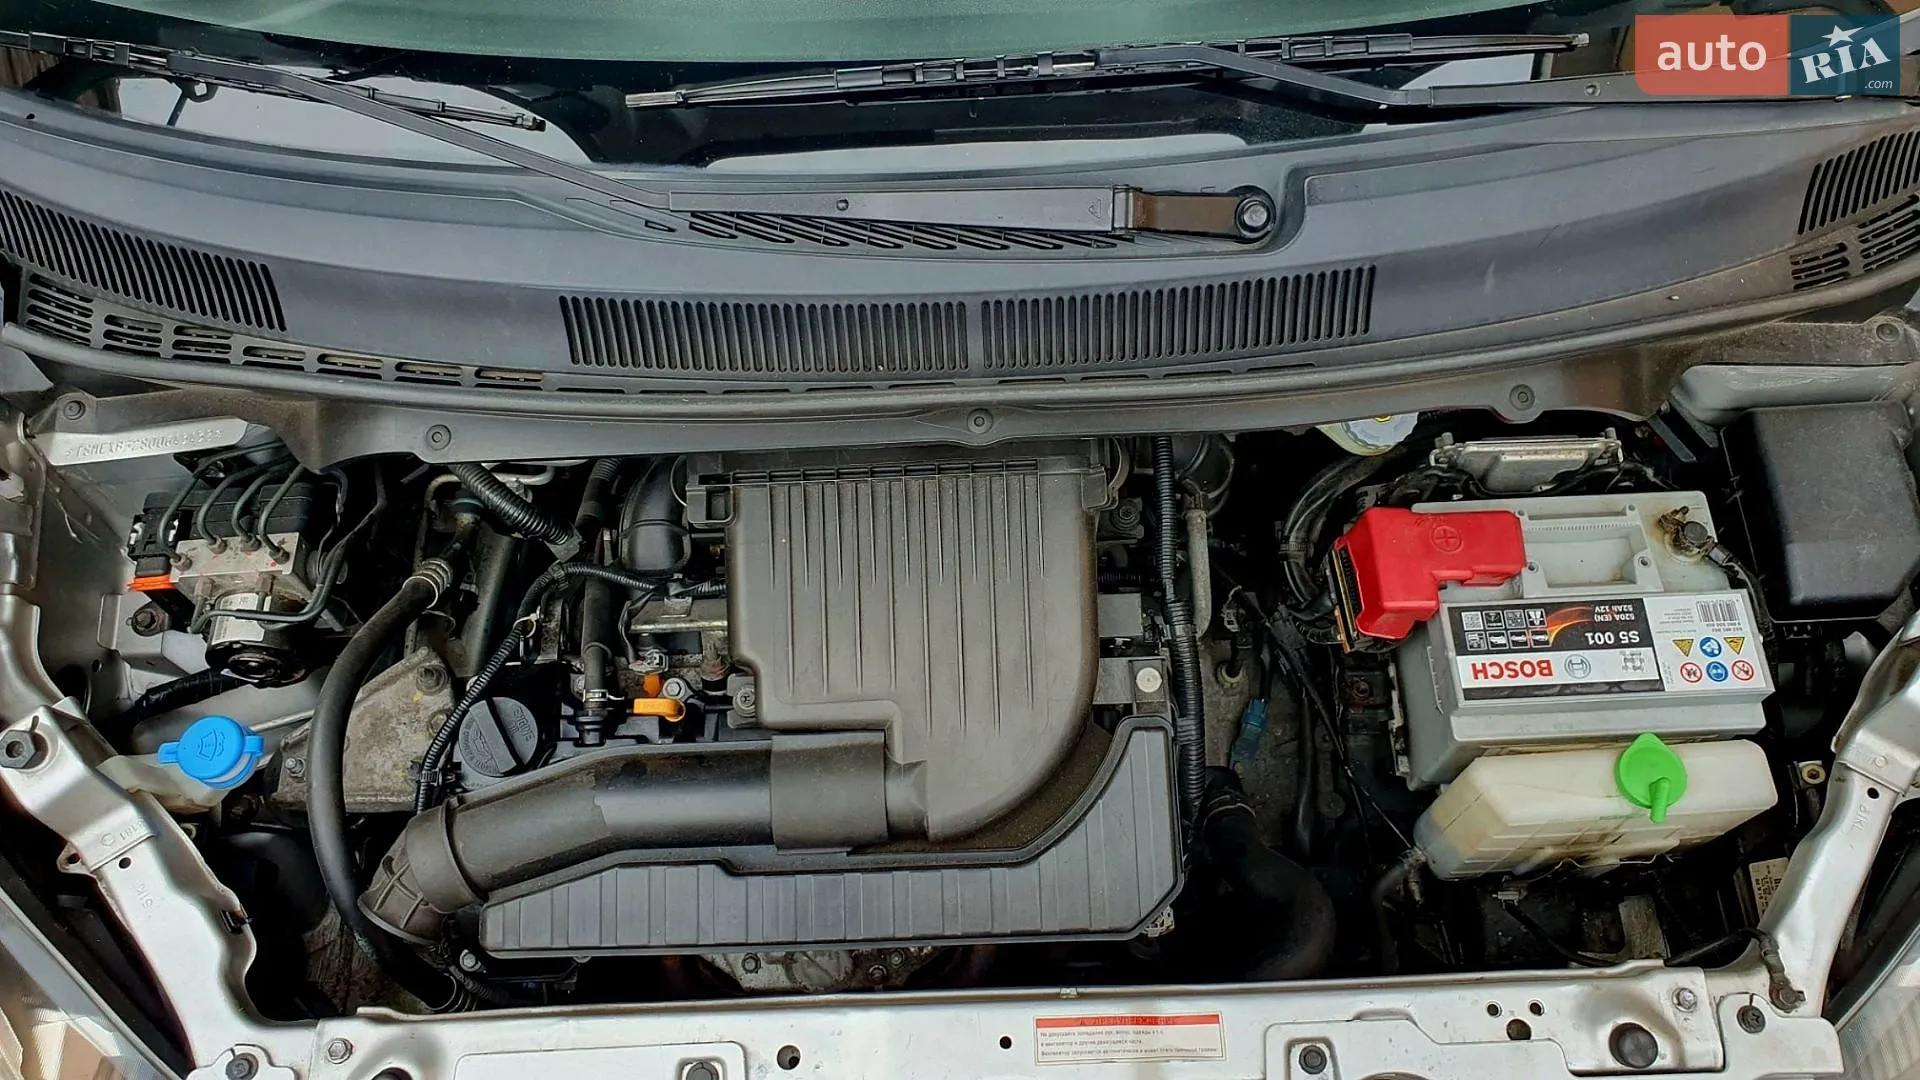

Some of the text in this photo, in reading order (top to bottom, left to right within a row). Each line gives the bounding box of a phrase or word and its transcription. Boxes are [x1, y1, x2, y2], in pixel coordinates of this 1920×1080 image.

[1585, 630, 1640, 645] S5 001
[1471, 659, 1554, 680] BOSCH
